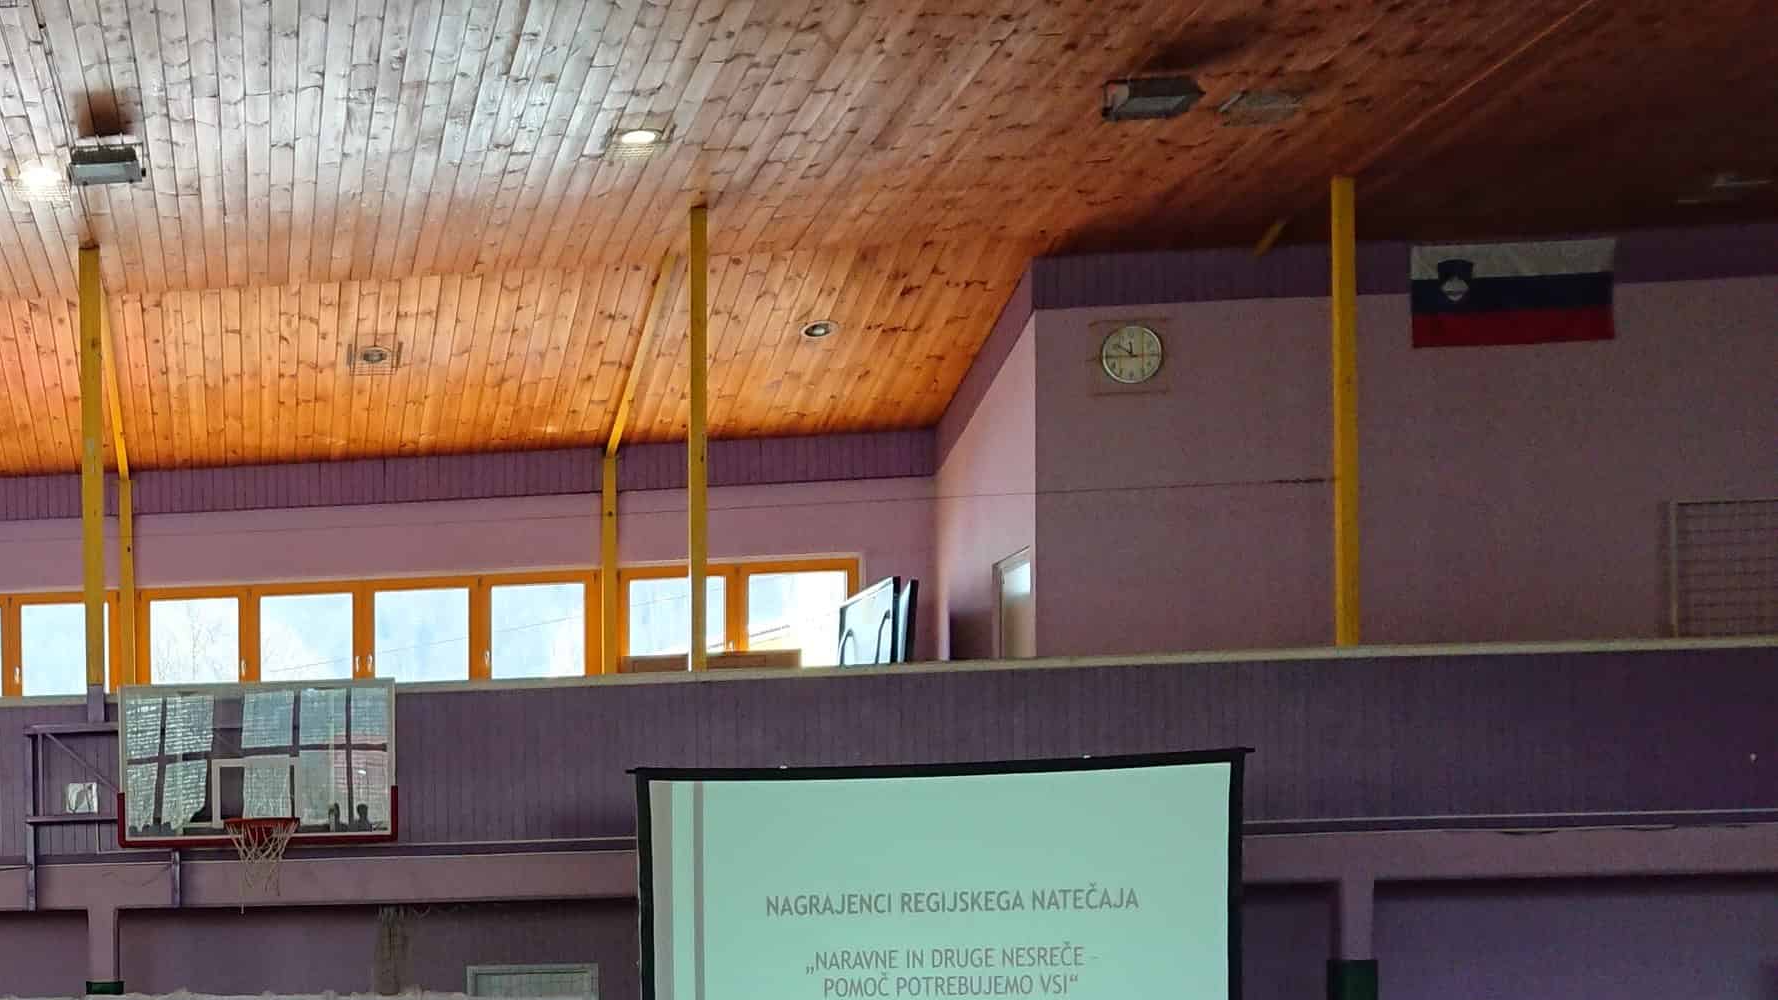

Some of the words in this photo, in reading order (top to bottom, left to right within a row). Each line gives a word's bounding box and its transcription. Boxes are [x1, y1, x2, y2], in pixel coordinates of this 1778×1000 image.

[765, 893, 893, 917] NAGRAJENCI
[900, 890, 1025, 914] REGIJSKEGA
[1031, 882, 1140, 911] NATEČAJA
[906, 950, 925, 969] IN
[931, 947, 996, 968] DRUGE
[1001, 940, 1085, 967] NESREČE
[823, 971, 890, 998] POMOČ
[896, 975, 1034, 997] POTREBUJEMO
